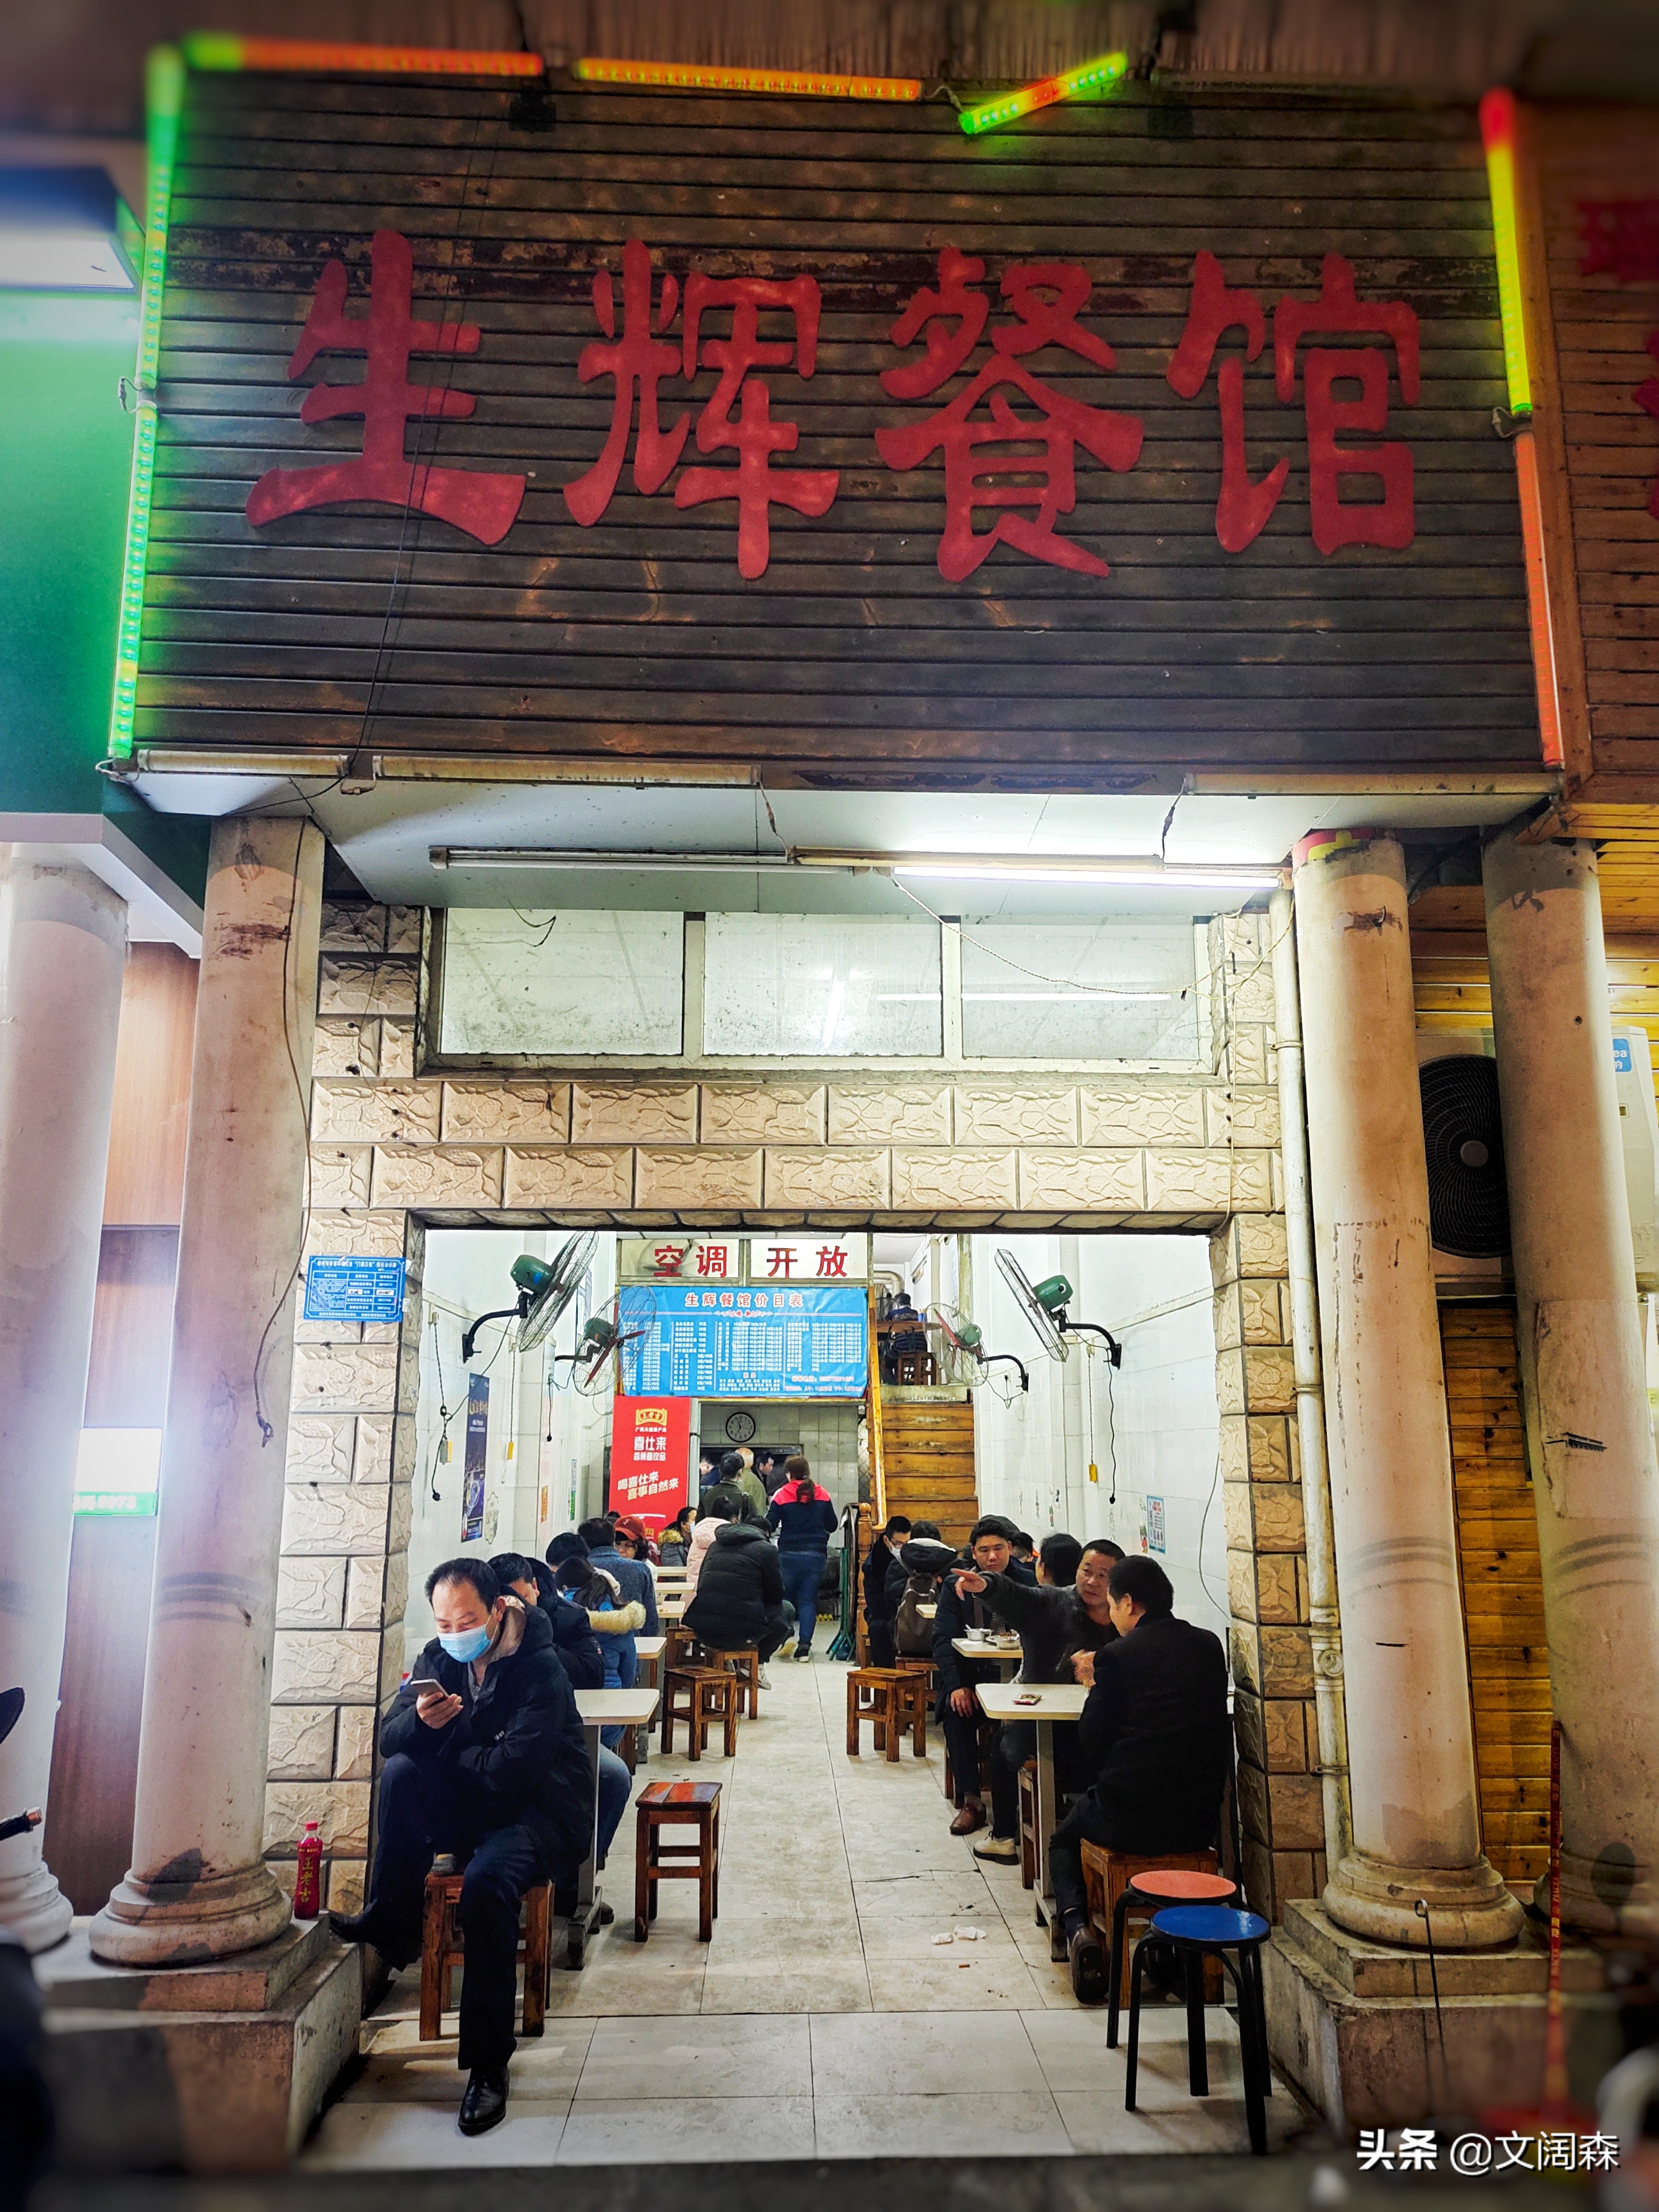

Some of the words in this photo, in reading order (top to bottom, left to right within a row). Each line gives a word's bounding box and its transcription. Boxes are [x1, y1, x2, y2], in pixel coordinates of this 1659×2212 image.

[247, 230, 1421, 582] 生辉餐馆
[653, 1245, 728, 1278] 空调
[766, 1245, 848, 1278] 开放
[685, 1292, 804, 1309] 生辉餐馆价目表
[634, 1436, 667, 1451] 喜仕来
[617, 1471, 659, 1491] 喝喜仕来
[627, 1478, 679, 1501] 喜事自然来
[299, 1856, 313, 1903] 王老吉
